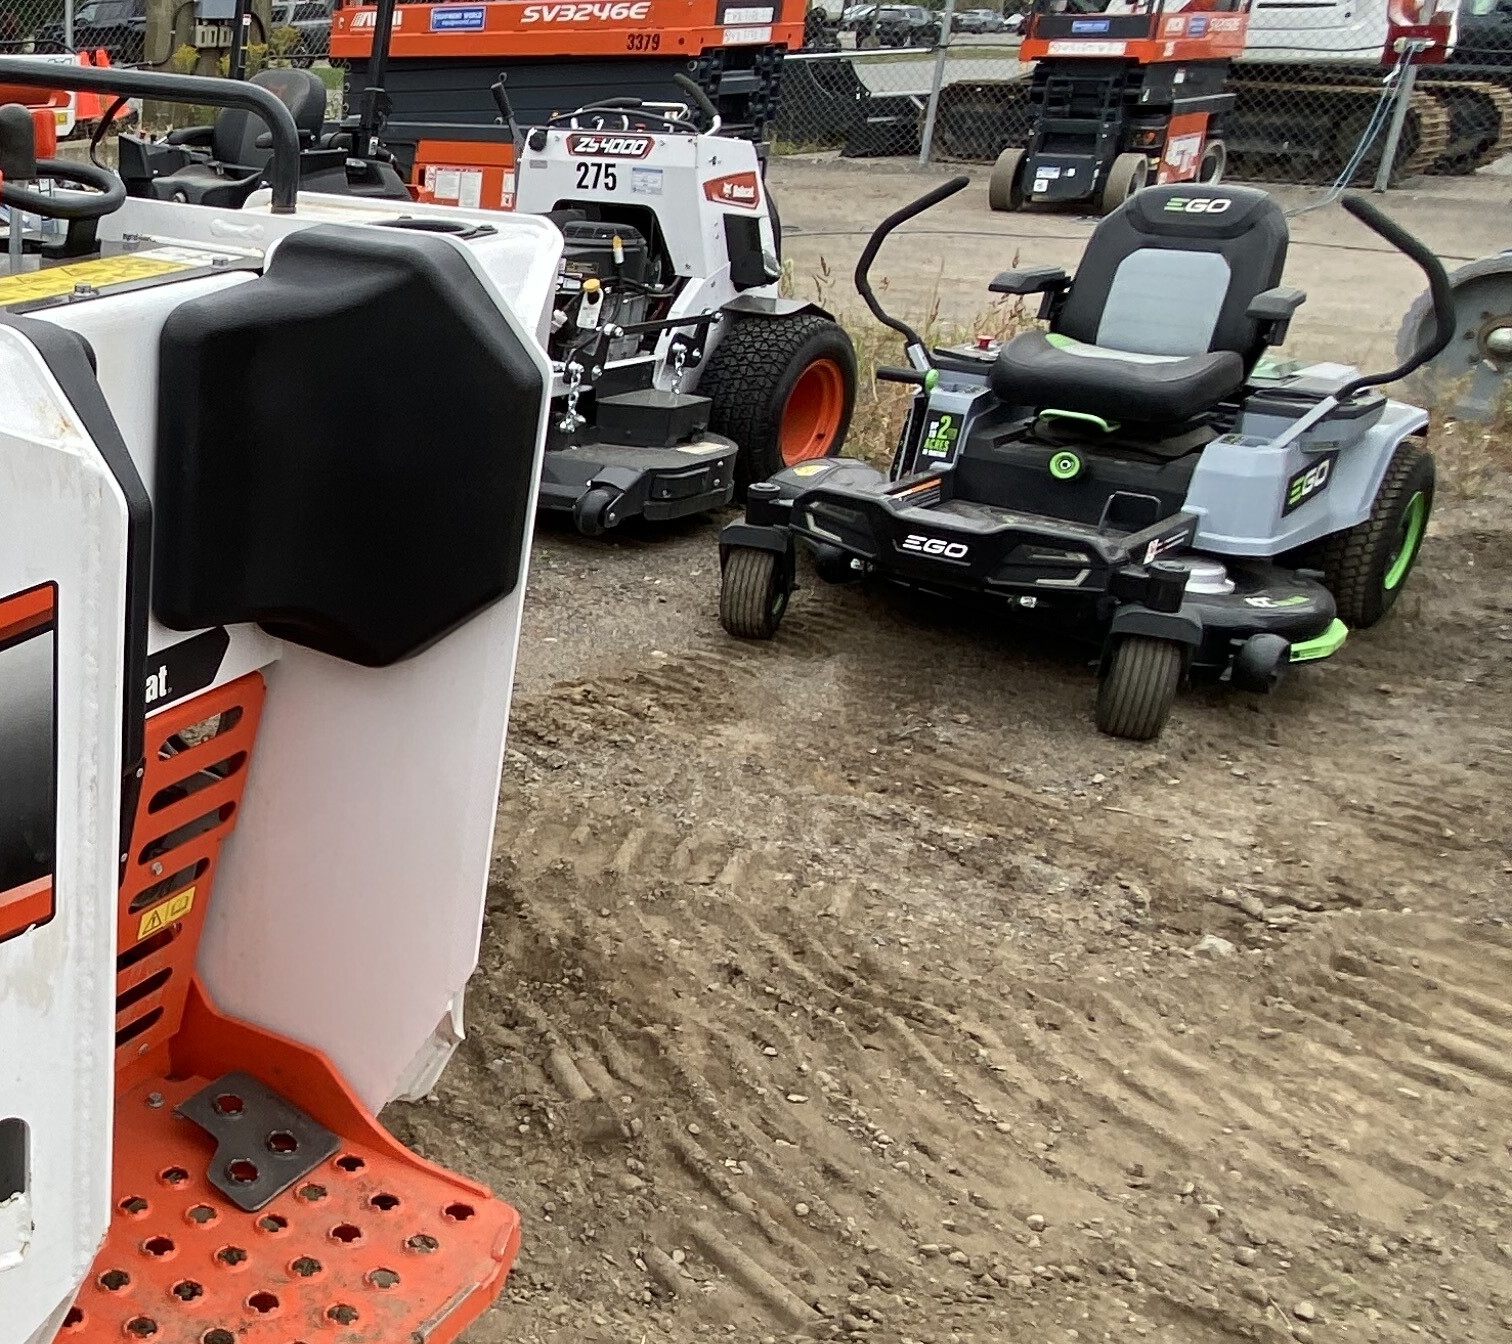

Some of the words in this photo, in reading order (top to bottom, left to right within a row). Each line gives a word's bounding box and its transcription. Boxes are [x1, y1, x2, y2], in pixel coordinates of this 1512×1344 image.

[520, 1, 652, 23] SV3246E
[626, 33, 660, 52] 3379
[576, 161, 617, 191] 275
[1164, 197, 1232, 213] EGO
[1288, 459, 1330, 505] EGO
[902, 534, 969, 558] EGO
